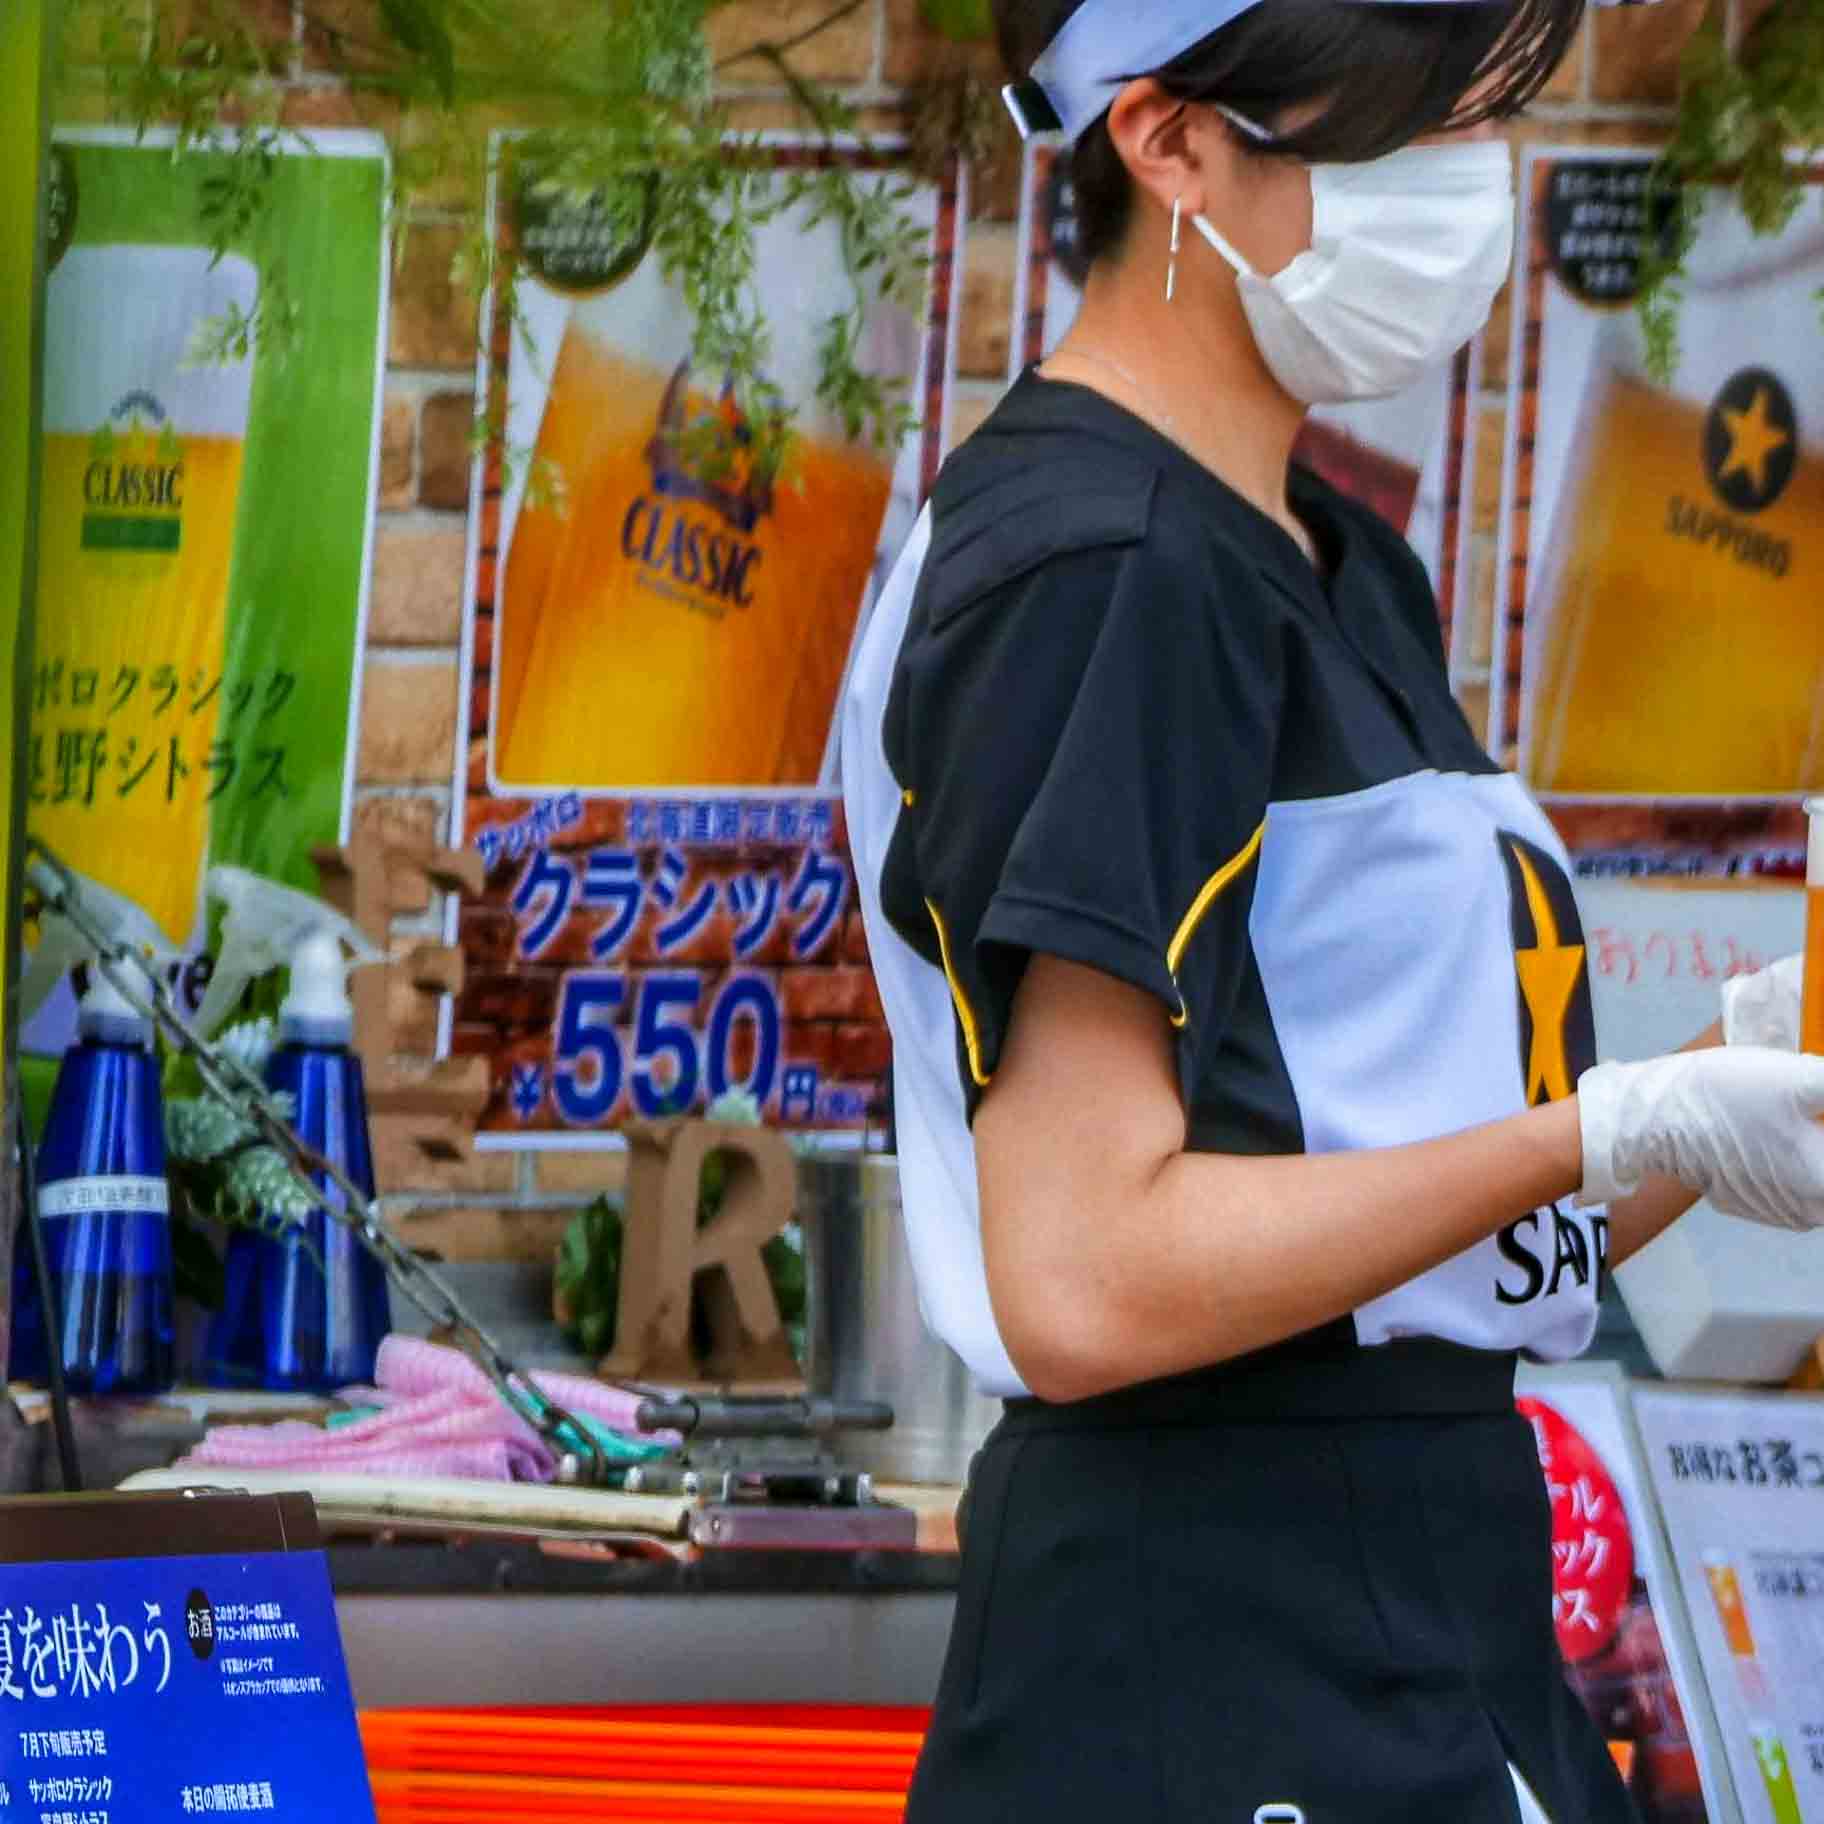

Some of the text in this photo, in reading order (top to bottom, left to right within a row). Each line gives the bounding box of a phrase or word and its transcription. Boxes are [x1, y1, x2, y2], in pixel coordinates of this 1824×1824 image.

[83, 460, 185, 508] CLASSIC
[621, 496, 763, 609] CLASSIC
[1660, 493, 1792, 579] SAPPORO
[513, 848, 848, 958] クラシック
[187, 1607, 213, 1639] お酒
[19, 1728, 107, 1758] 7月下旬販売予定
[29, 1776, 112, 1804] サッポロクラシック
